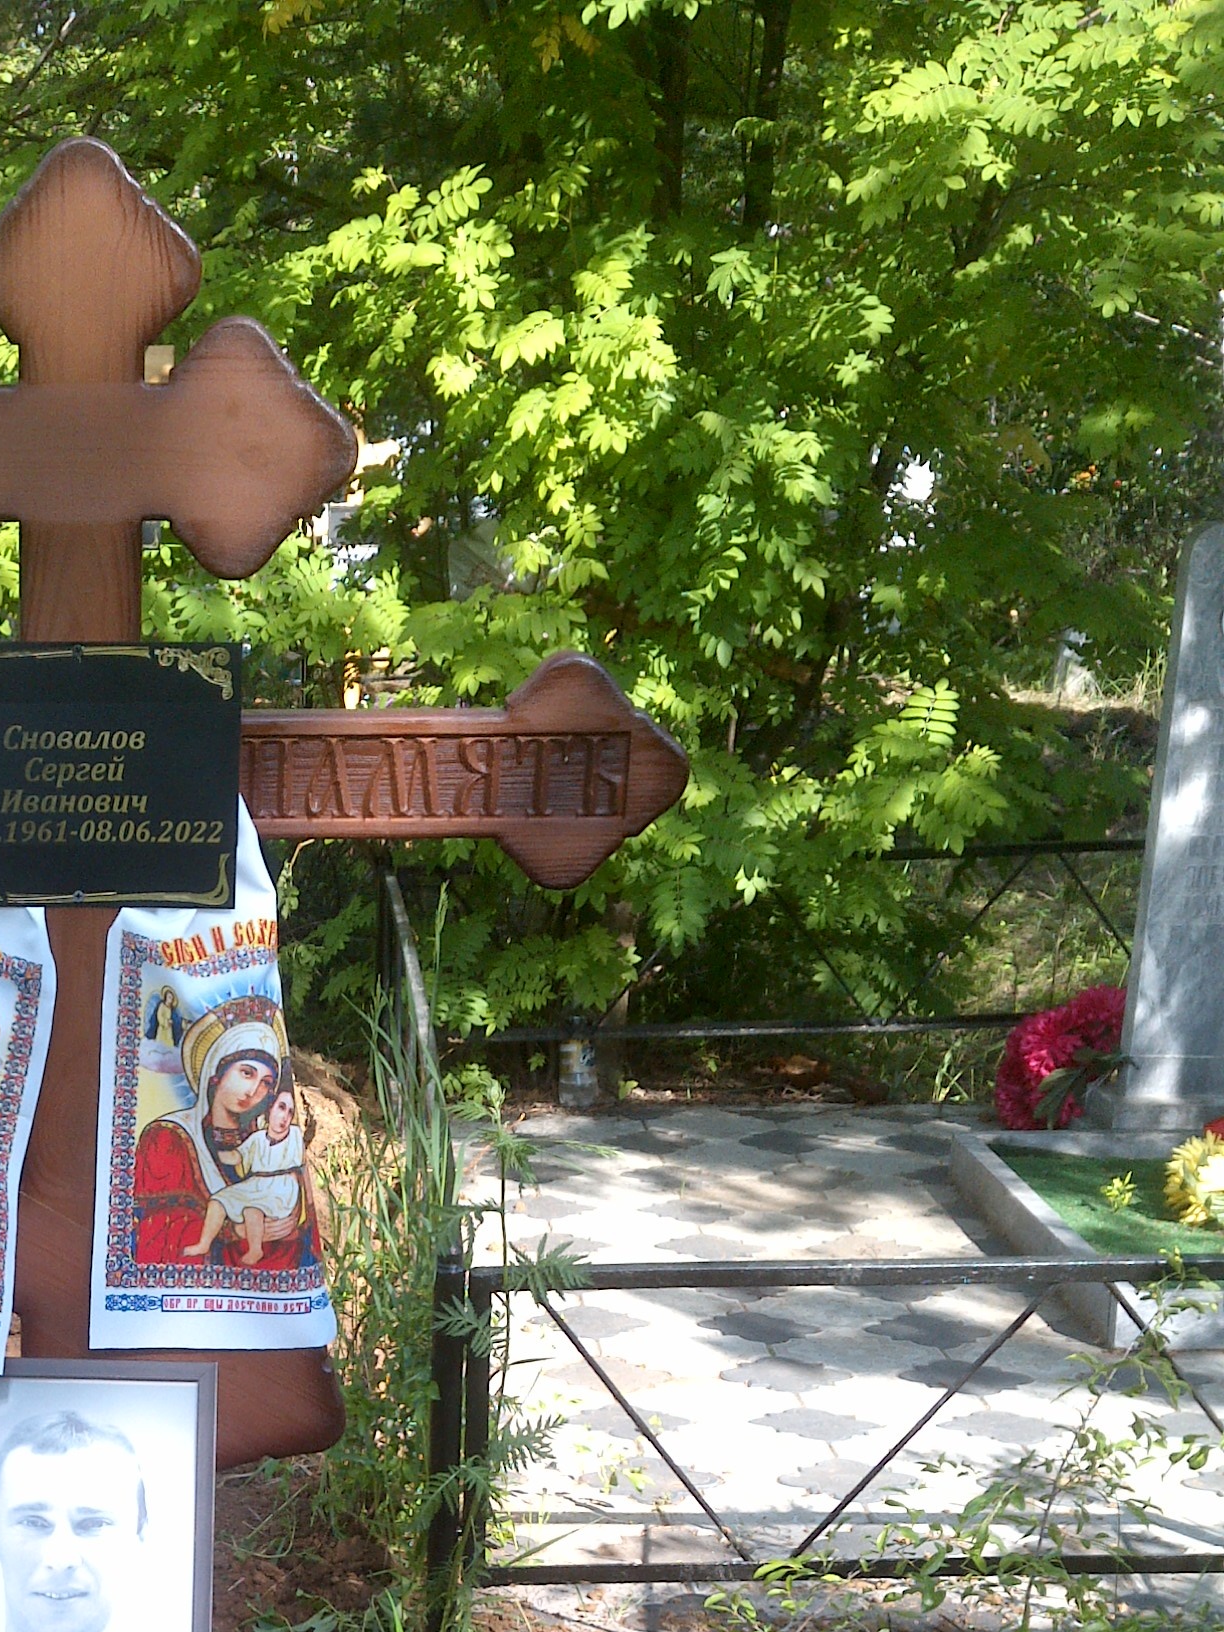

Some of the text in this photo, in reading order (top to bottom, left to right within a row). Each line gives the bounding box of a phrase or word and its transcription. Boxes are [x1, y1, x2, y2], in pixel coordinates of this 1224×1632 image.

[3, 724, 146, 751] Сновалов
[25, 755, 125, 788] Сергей
[242, 736, 625, 819] ПАМЯТЬ
[0, 788, 147, 815] Иванович
